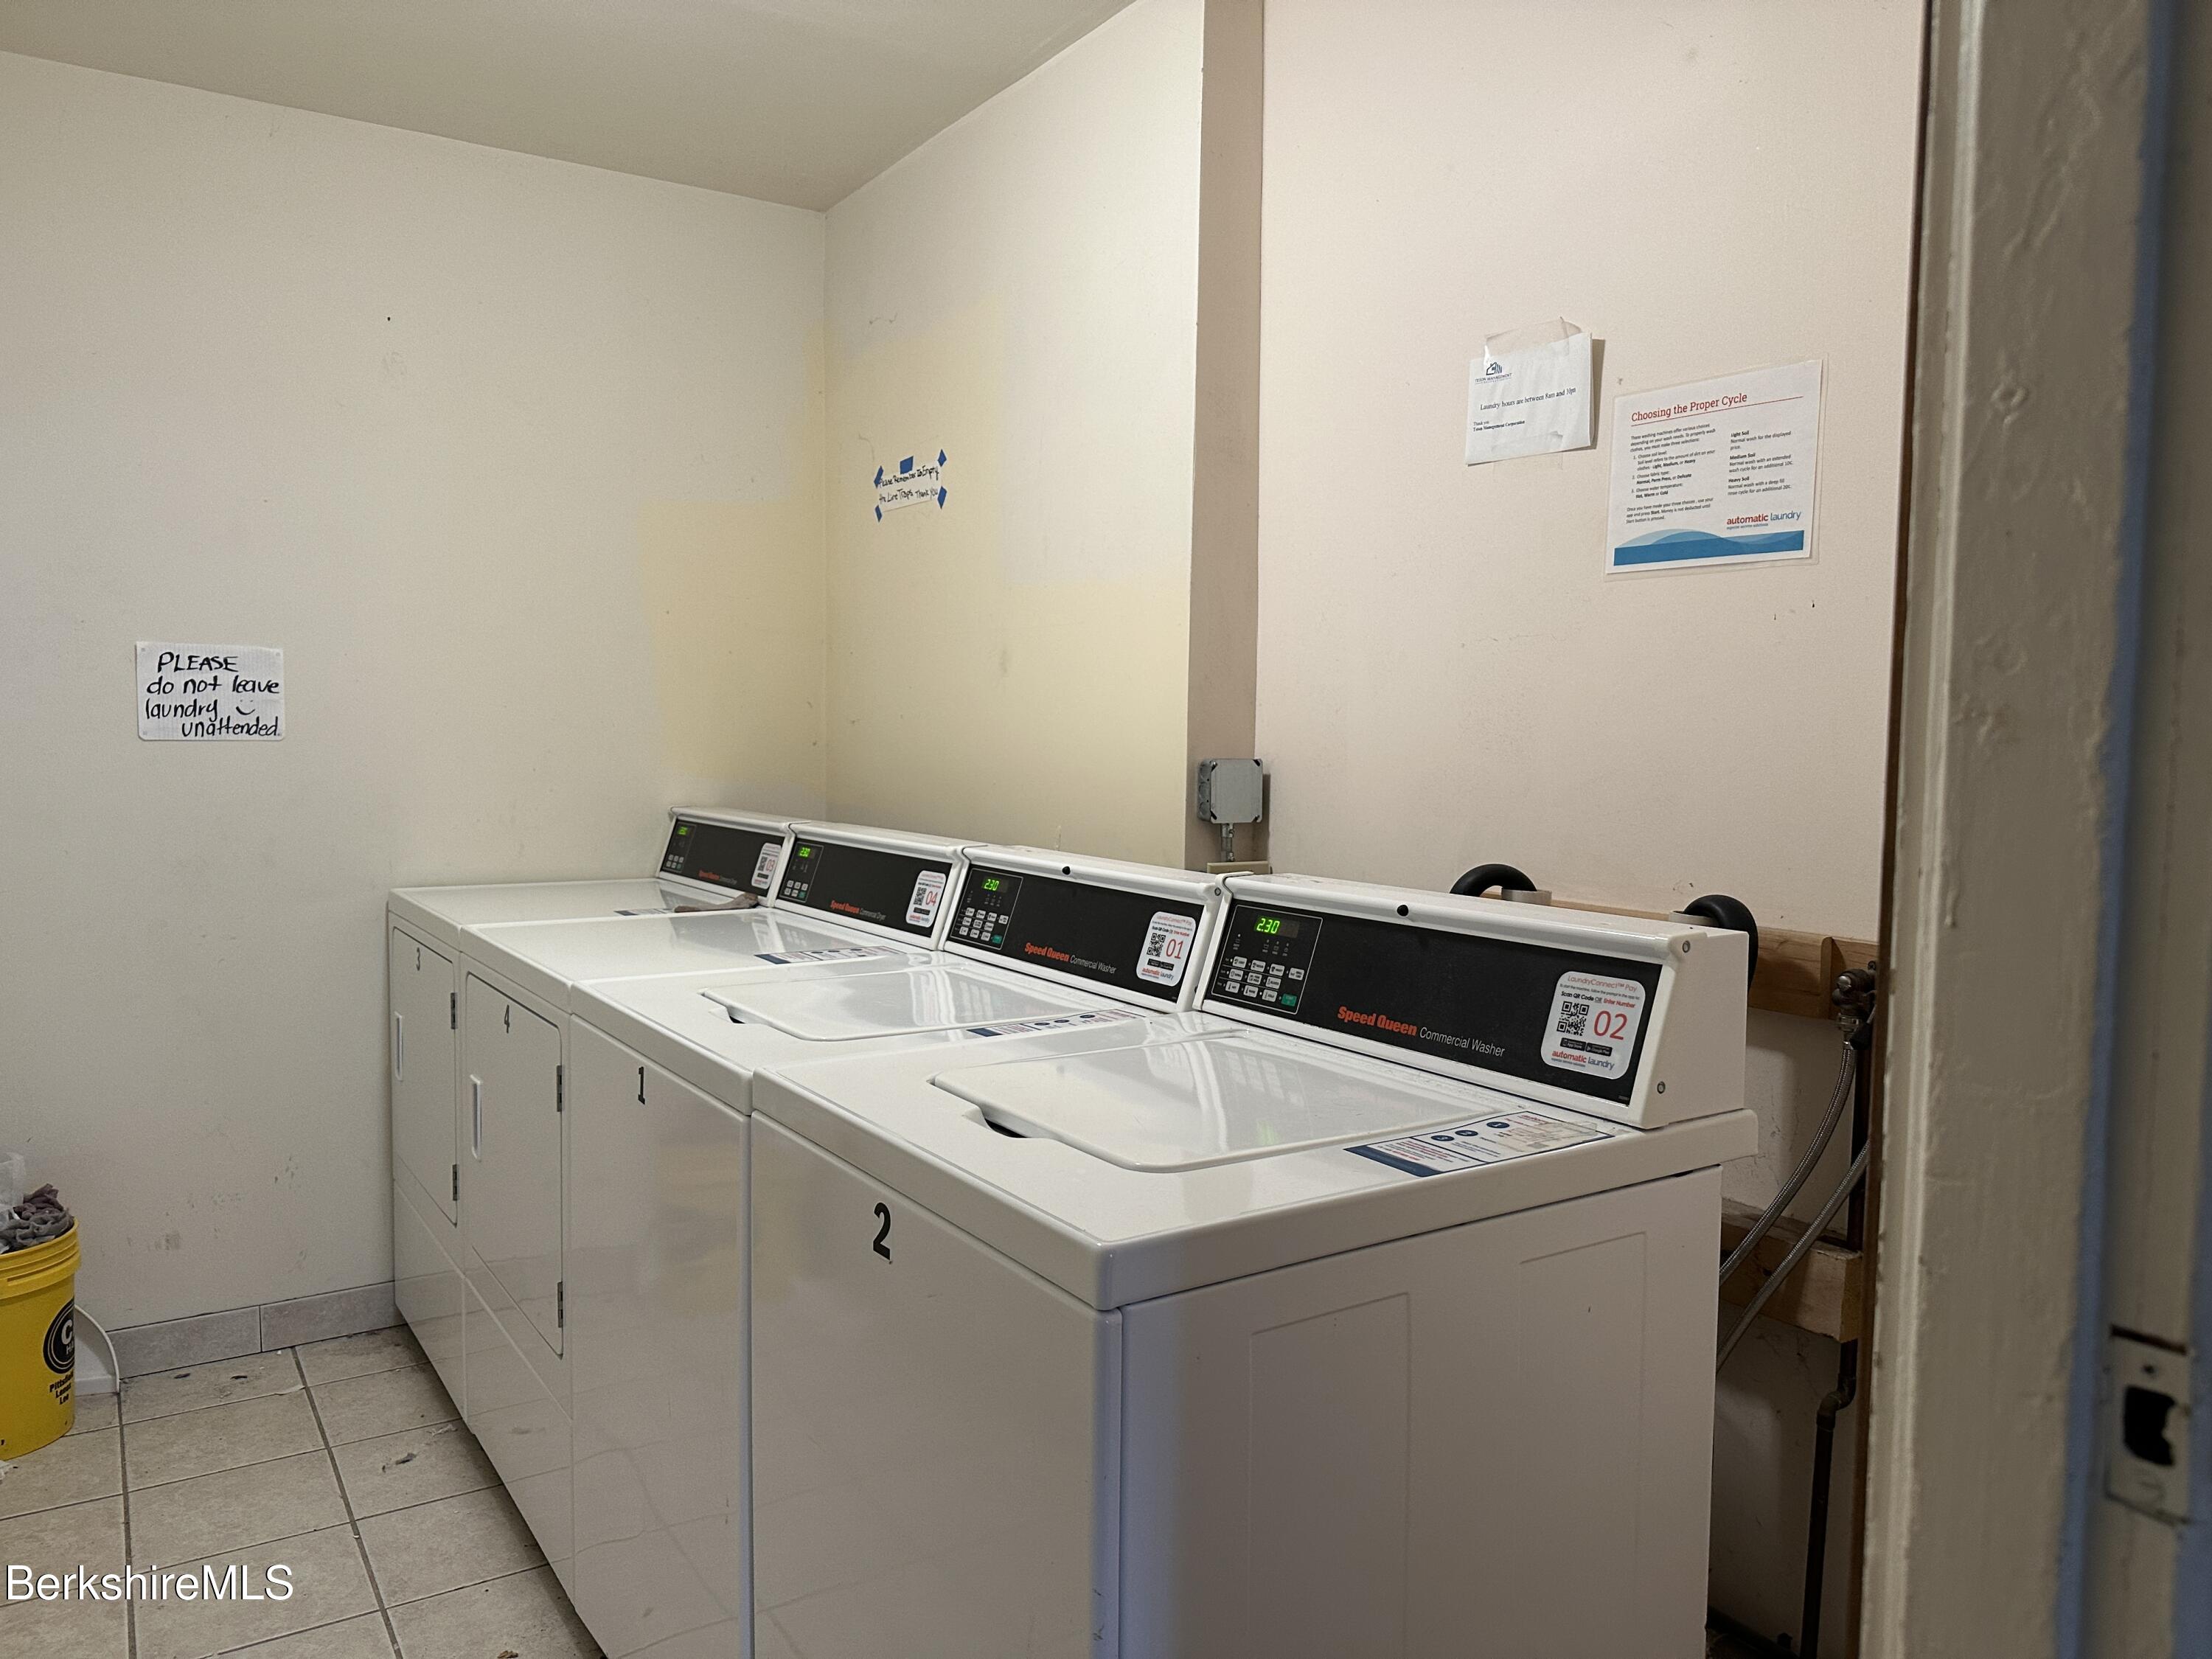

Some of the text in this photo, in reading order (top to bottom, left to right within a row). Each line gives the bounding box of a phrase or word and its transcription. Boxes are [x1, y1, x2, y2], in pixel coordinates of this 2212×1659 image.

[1480, 403, 1500, 411] Laundry
[1501, 400, 1515, 408] hours
[1524, 395, 1544, 403] between
[1632, 393, 1747, 422] Choosing the Proper Cycle
[922, 465, 939, 481] Empty
[915, 490, 930, 499] Thank
[1727, 510, 1801, 525] automatic laundry
[157, 651, 239, 672] PLEASE
[147, 675, 280, 695] do not leave
[145, 698, 218, 722] laundry
[925, 891, 939, 906] 04
[1256, 917, 1280, 934] 2.30
[415, 947, 421, 972] 3
[1024, 942, 1116, 974] Speed Queen Commercial Washer
[1166, 939, 1184, 960] 01
[1160, 972, 1174, 981] laundry
[1625, 984, 1638, 992] Pay
[1616, 1000, 1635, 1008] Number
[504, 1004, 510, 1034] 4
[1593, 1010, 1627, 1040] 02
[1337, 1006, 1506, 1057] Speed Queen Commercial Washer
[1551, 1050, 1587, 1063] automatic
[1587, 1056, 1615, 1071] laundry
[638, 1066, 646, 1105] 1
[873, 1202, 891, 1261] 2
